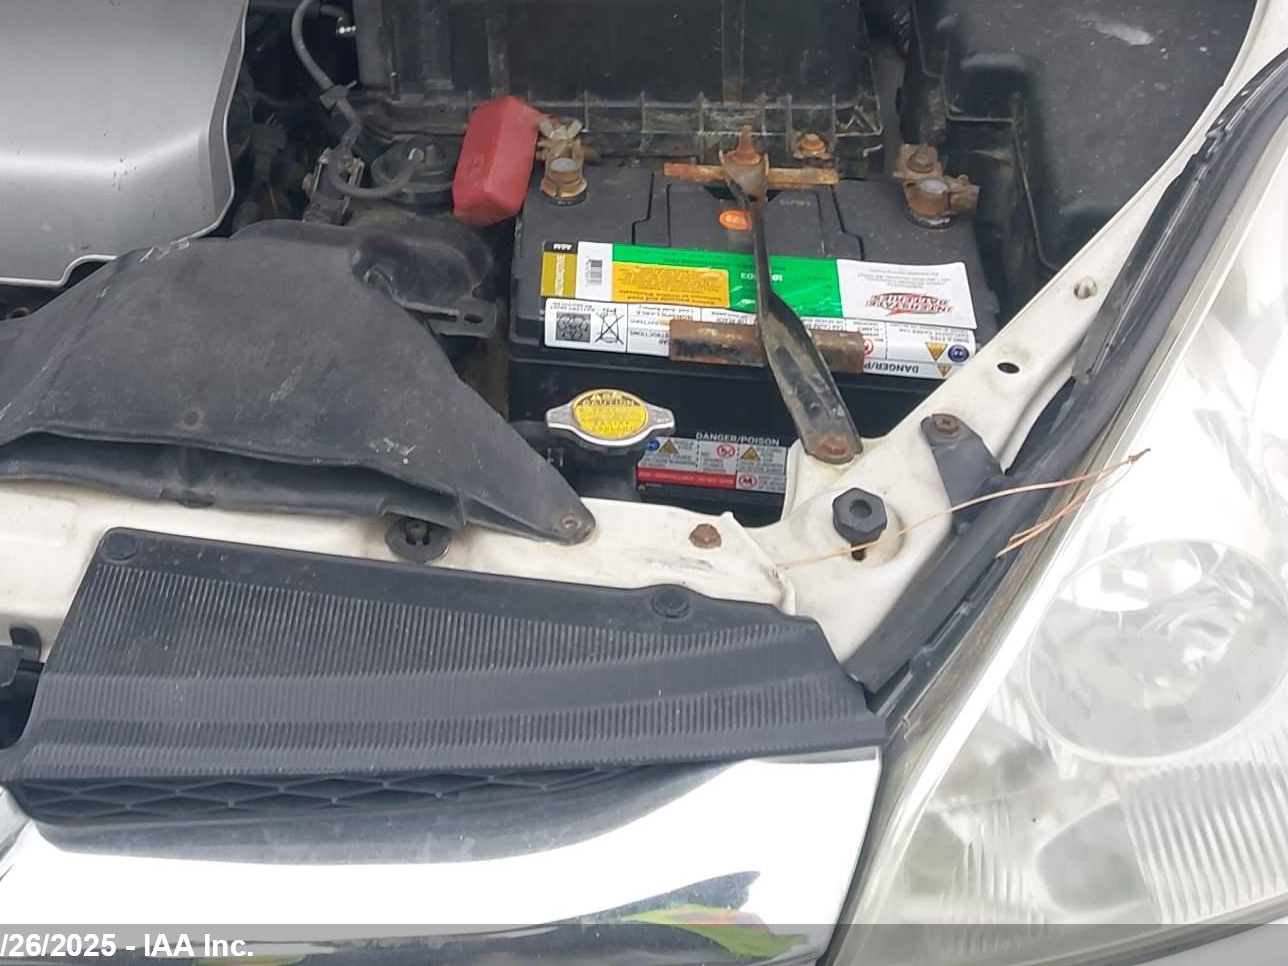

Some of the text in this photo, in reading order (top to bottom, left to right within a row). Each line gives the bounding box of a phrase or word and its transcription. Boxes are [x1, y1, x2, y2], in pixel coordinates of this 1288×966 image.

[865, 301, 953, 315] INTERSTATE
[870, 294, 951, 308] BATTERIES
[696, 432, 780, 446] DANGER/POISON
